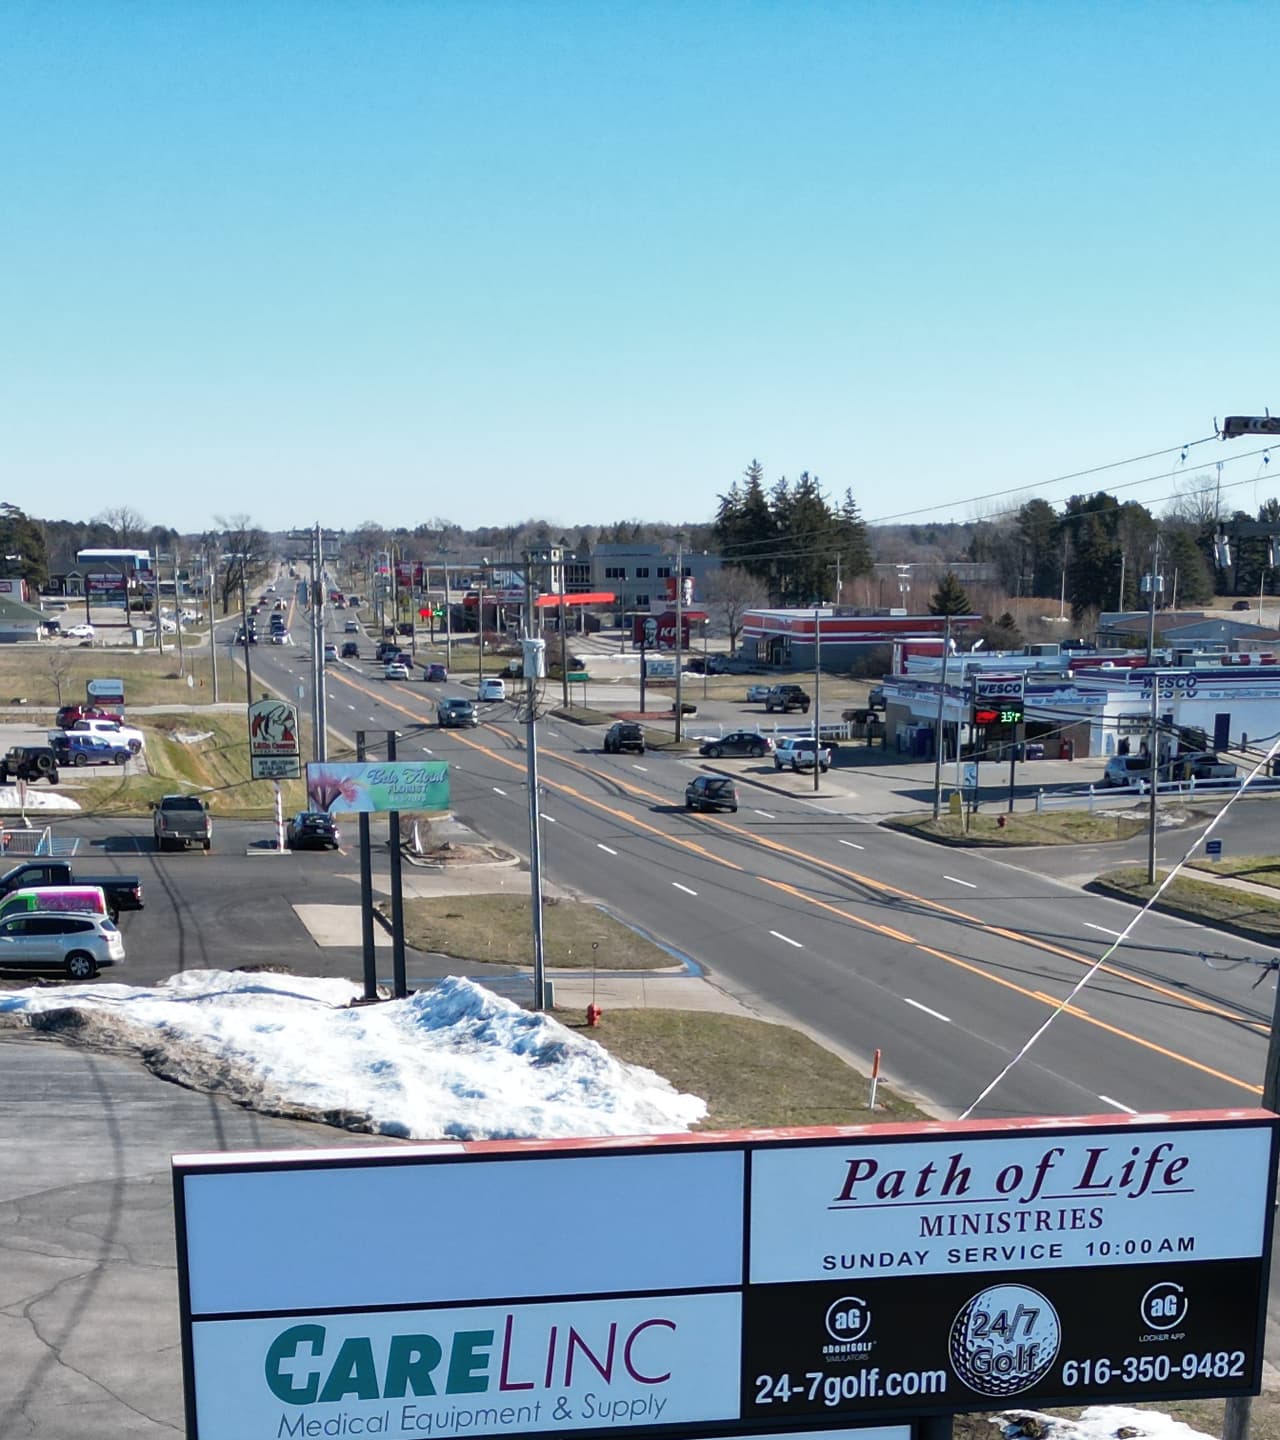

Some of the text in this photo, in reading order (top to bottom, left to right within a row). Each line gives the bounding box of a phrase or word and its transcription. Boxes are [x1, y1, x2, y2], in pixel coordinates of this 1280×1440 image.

[977, 683, 1022, 694] WESCO
[1142, 677, 1198, 689] WESCO
[832, 1142, 1190, 1204] Path of Life
[919, 1206, 1104, 1238] MINISTRIES
[822, 1251, 930, 1270] SUNDAY
[947, 1243, 1064, 1264] SERVICE
[835, 1308, 861, 1330] aG
[1150, 1293, 1178, 1317] aG
[970, 1303, 1041, 1344] 24/7
[1138, 1332, 1186, 1343] LOCKER APP
[968, 1343, 1041, 1376] Golf
[1061, 1350, 1246, 1387] 616-350-9482
[754, 1367, 947, 1407] 24-7golf.com
[276, 1392, 668, 1440] Medical Equipment & Supply
